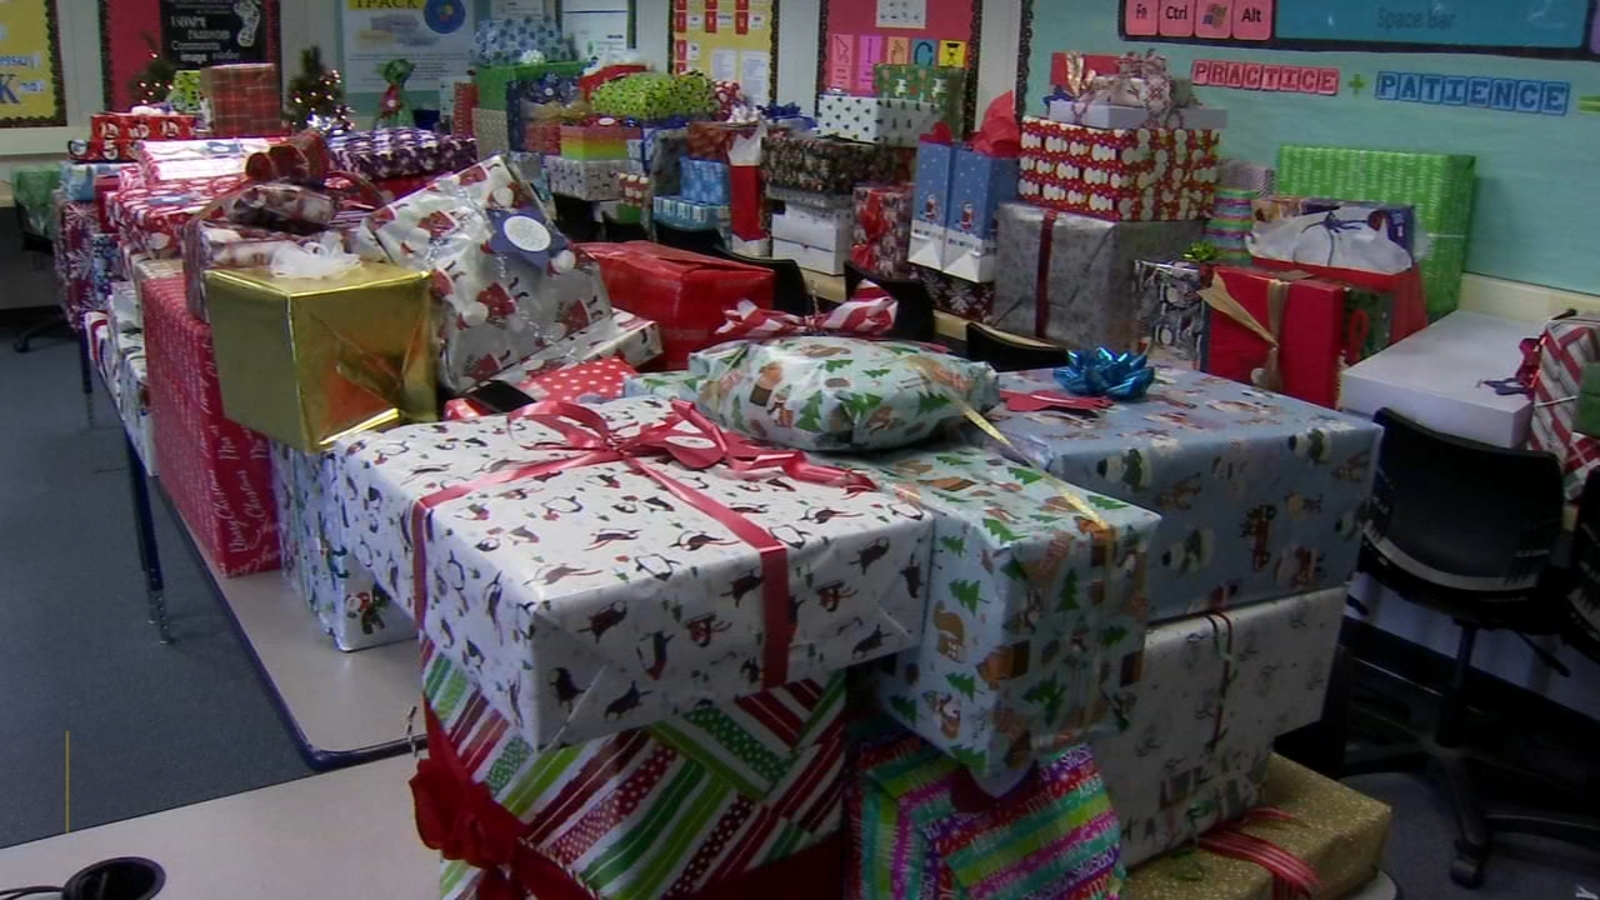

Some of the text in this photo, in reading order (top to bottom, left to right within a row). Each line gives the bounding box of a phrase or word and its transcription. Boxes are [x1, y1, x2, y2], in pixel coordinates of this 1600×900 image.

[1165, 5, 1188, 20] Ctrl
[1241, 8, 1262, 22] Alt
[1377, 7, 1457, 31] Space Bar
[1193, 62, 1337, 93] PRACTICE
[1379, 75, 1565, 112] PATIENCE
